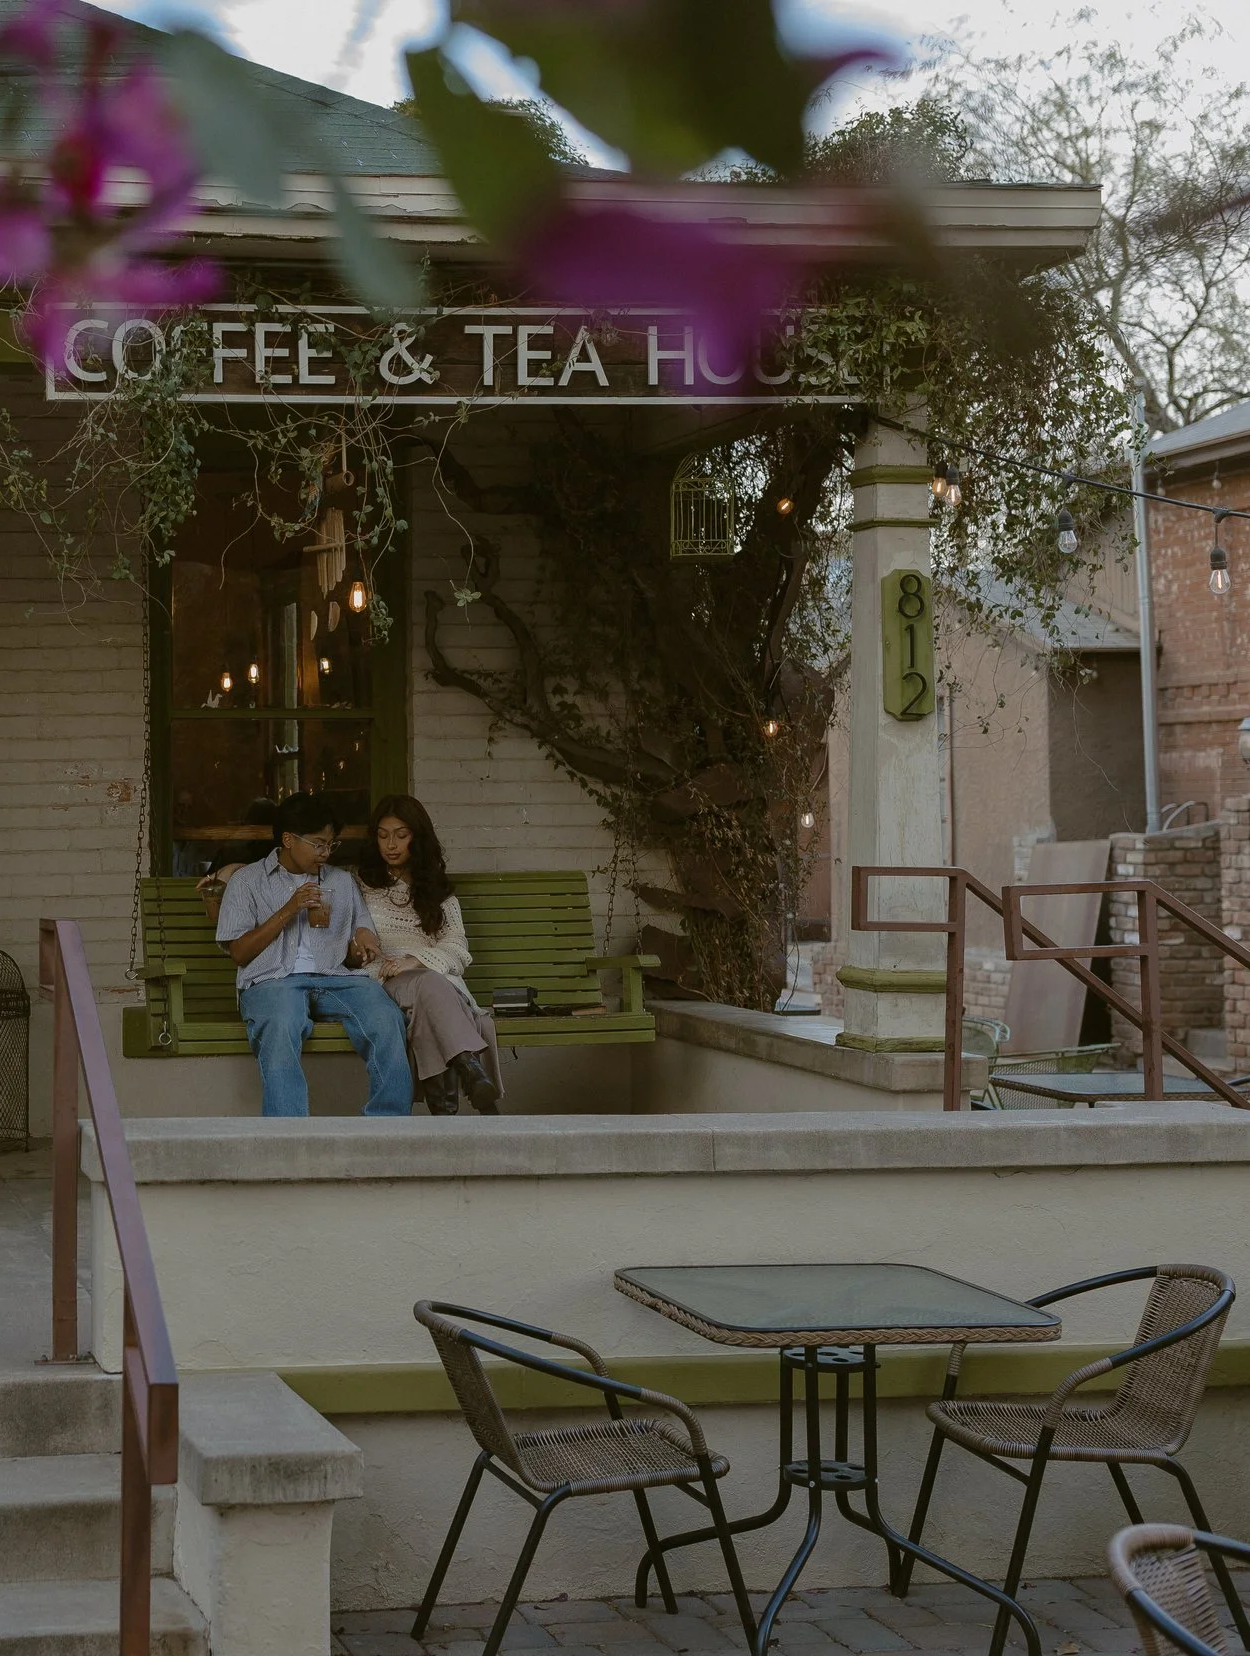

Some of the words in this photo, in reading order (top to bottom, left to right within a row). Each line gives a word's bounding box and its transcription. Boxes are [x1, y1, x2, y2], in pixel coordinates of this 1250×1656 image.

[379, 322, 434, 385] &
[464, 325, 609, 386] TEA
[897, 573, 927, 717] 812
